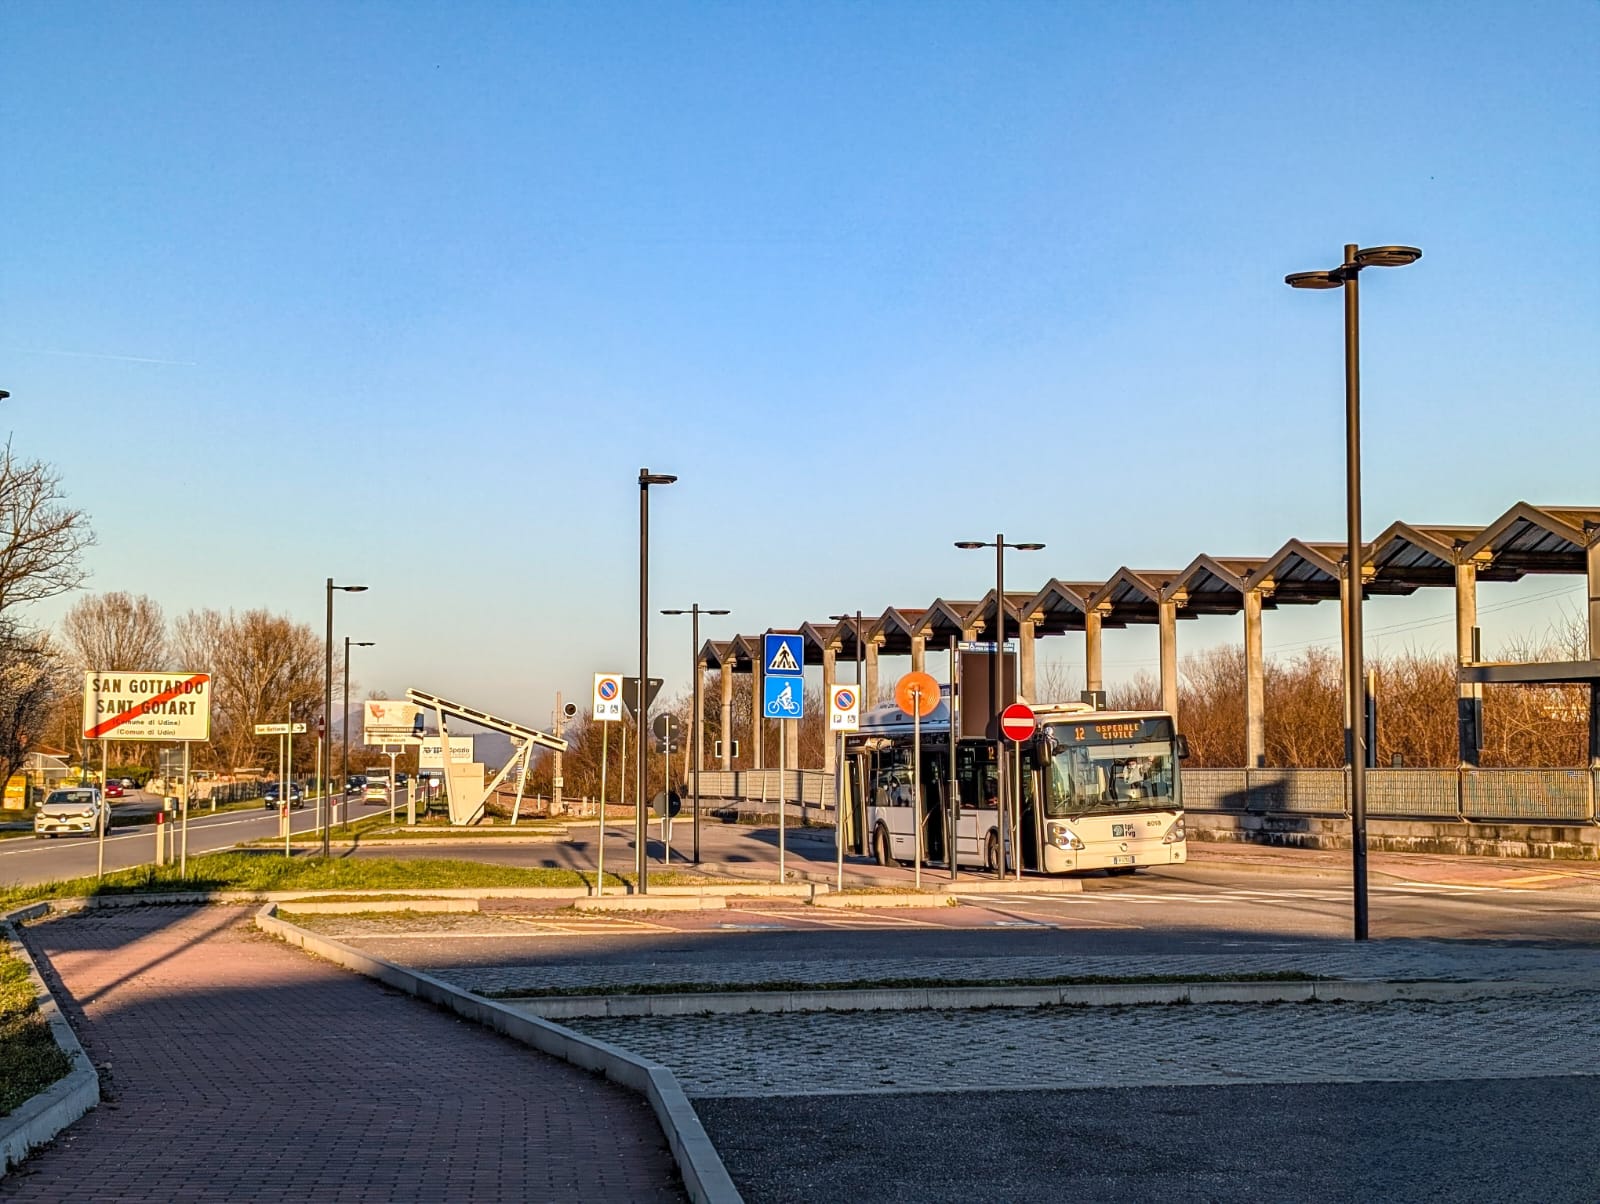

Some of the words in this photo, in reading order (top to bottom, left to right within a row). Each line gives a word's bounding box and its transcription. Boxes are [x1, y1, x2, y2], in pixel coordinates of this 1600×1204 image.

[92, 678, 122, 693] SAN
[129, 679, 203, 694] GOTTARDO
[96, 700, 134, 714] SANT
[142, 700, 196, 715] GOTART
[1075, 728, 1085, 740] 12
[1096, 723, 1139, 732] OSPEDALE
[1102, 731, 1133, 739] CIVILE
